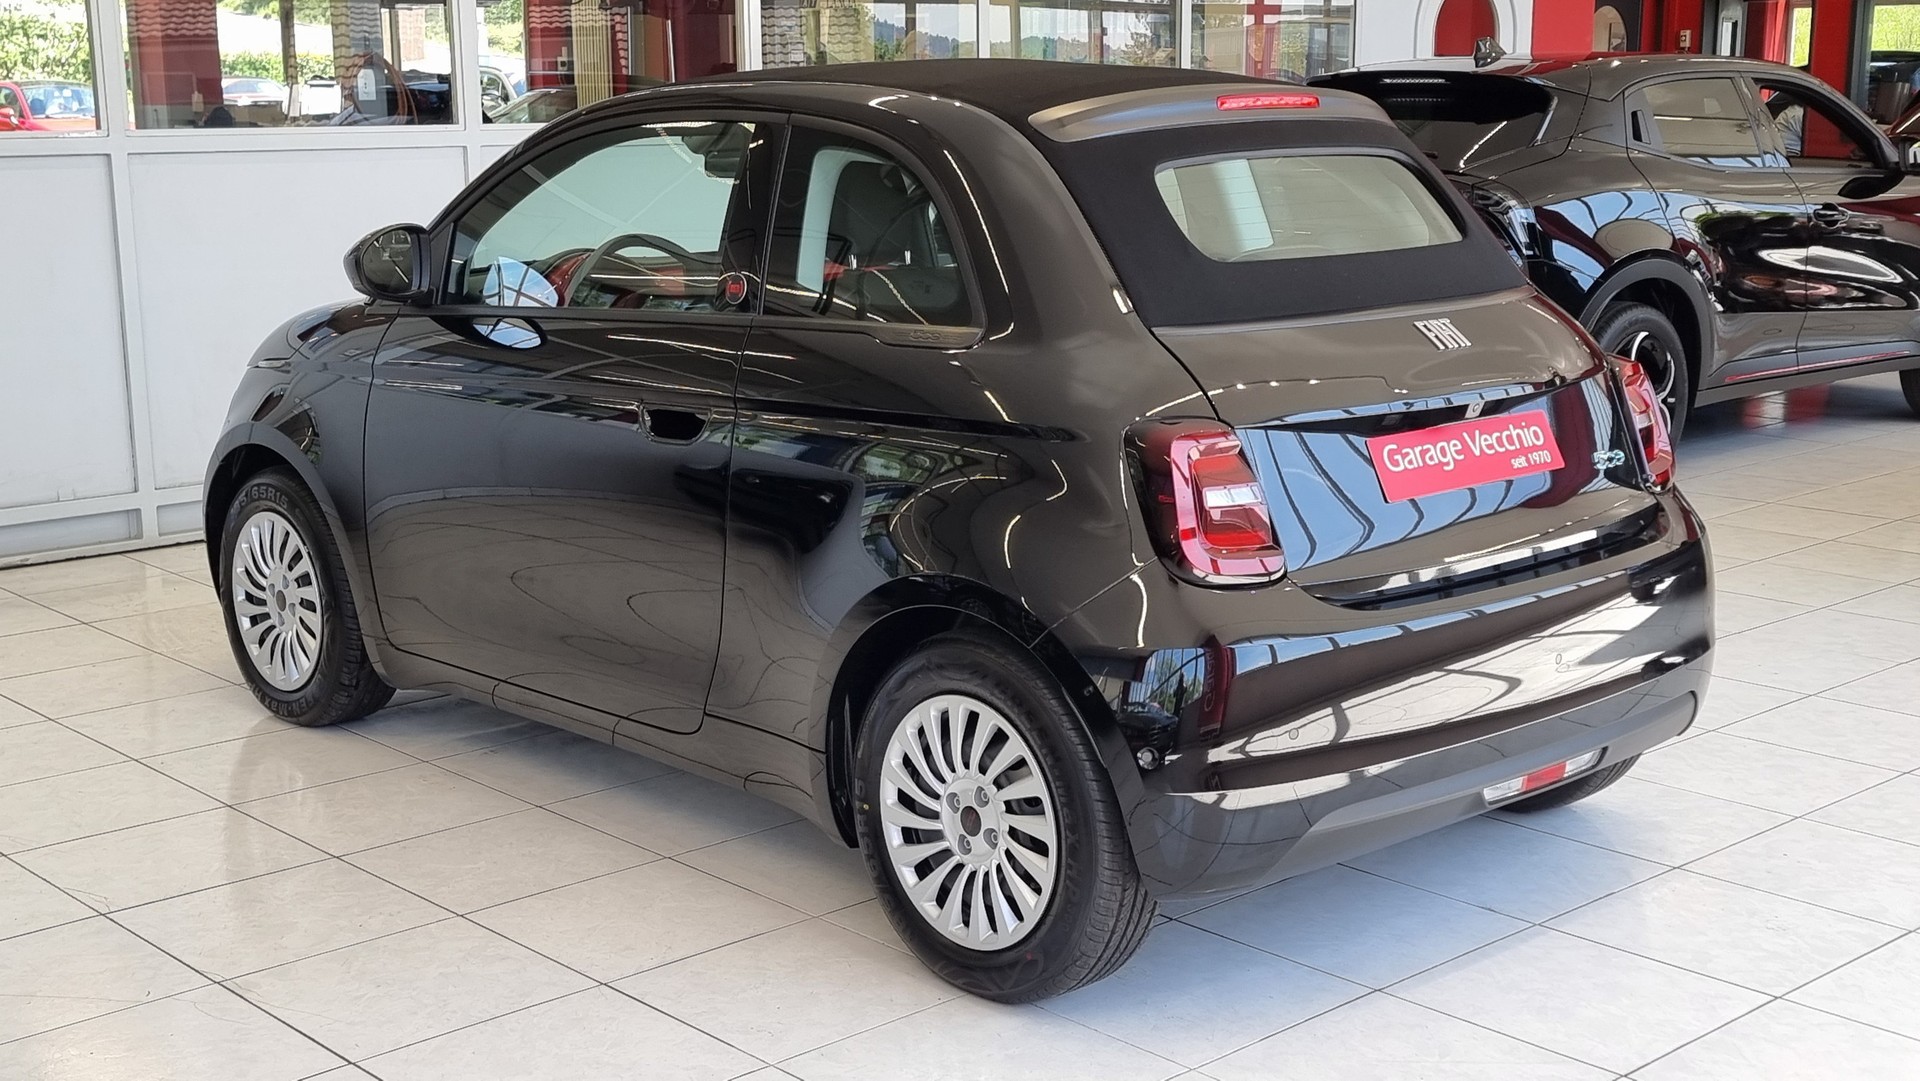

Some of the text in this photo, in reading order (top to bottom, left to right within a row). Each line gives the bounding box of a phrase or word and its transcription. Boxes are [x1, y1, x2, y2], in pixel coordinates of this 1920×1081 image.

[1413, 317, 1472, 350] FIAT
[1383, 422, 1544, 472] Garage Vecchio
[1511, 450, 1551, 469] seit 1970
